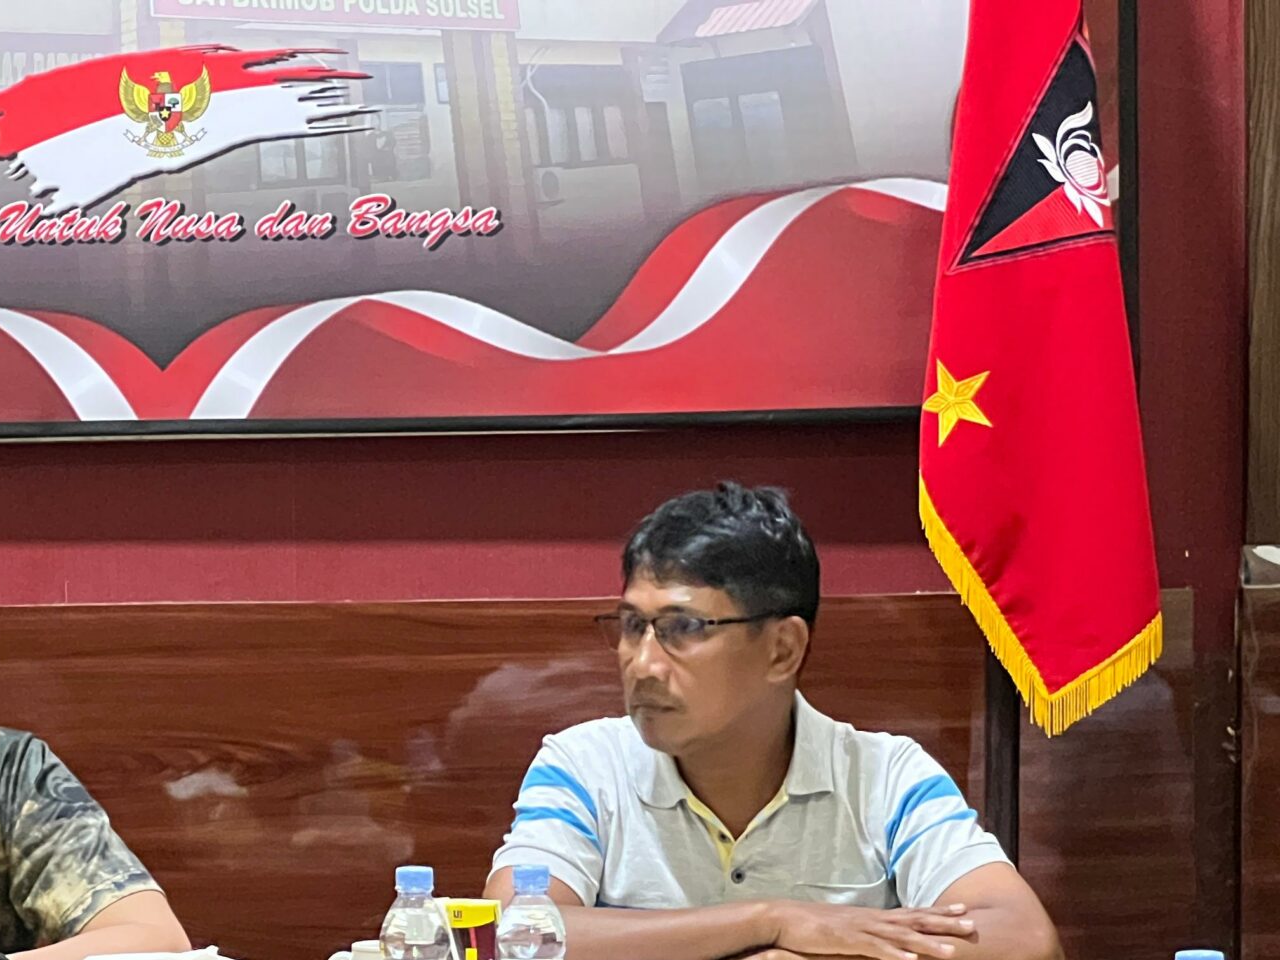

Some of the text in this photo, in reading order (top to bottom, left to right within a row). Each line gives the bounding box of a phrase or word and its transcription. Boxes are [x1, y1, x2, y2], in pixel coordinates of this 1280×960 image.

[426, 0, 505, 20] SULSEL
[134, 197, 242, 243] Nusa
[254, 199, 334, 240] dan
[347, 193, 501, 249] Bangsa
